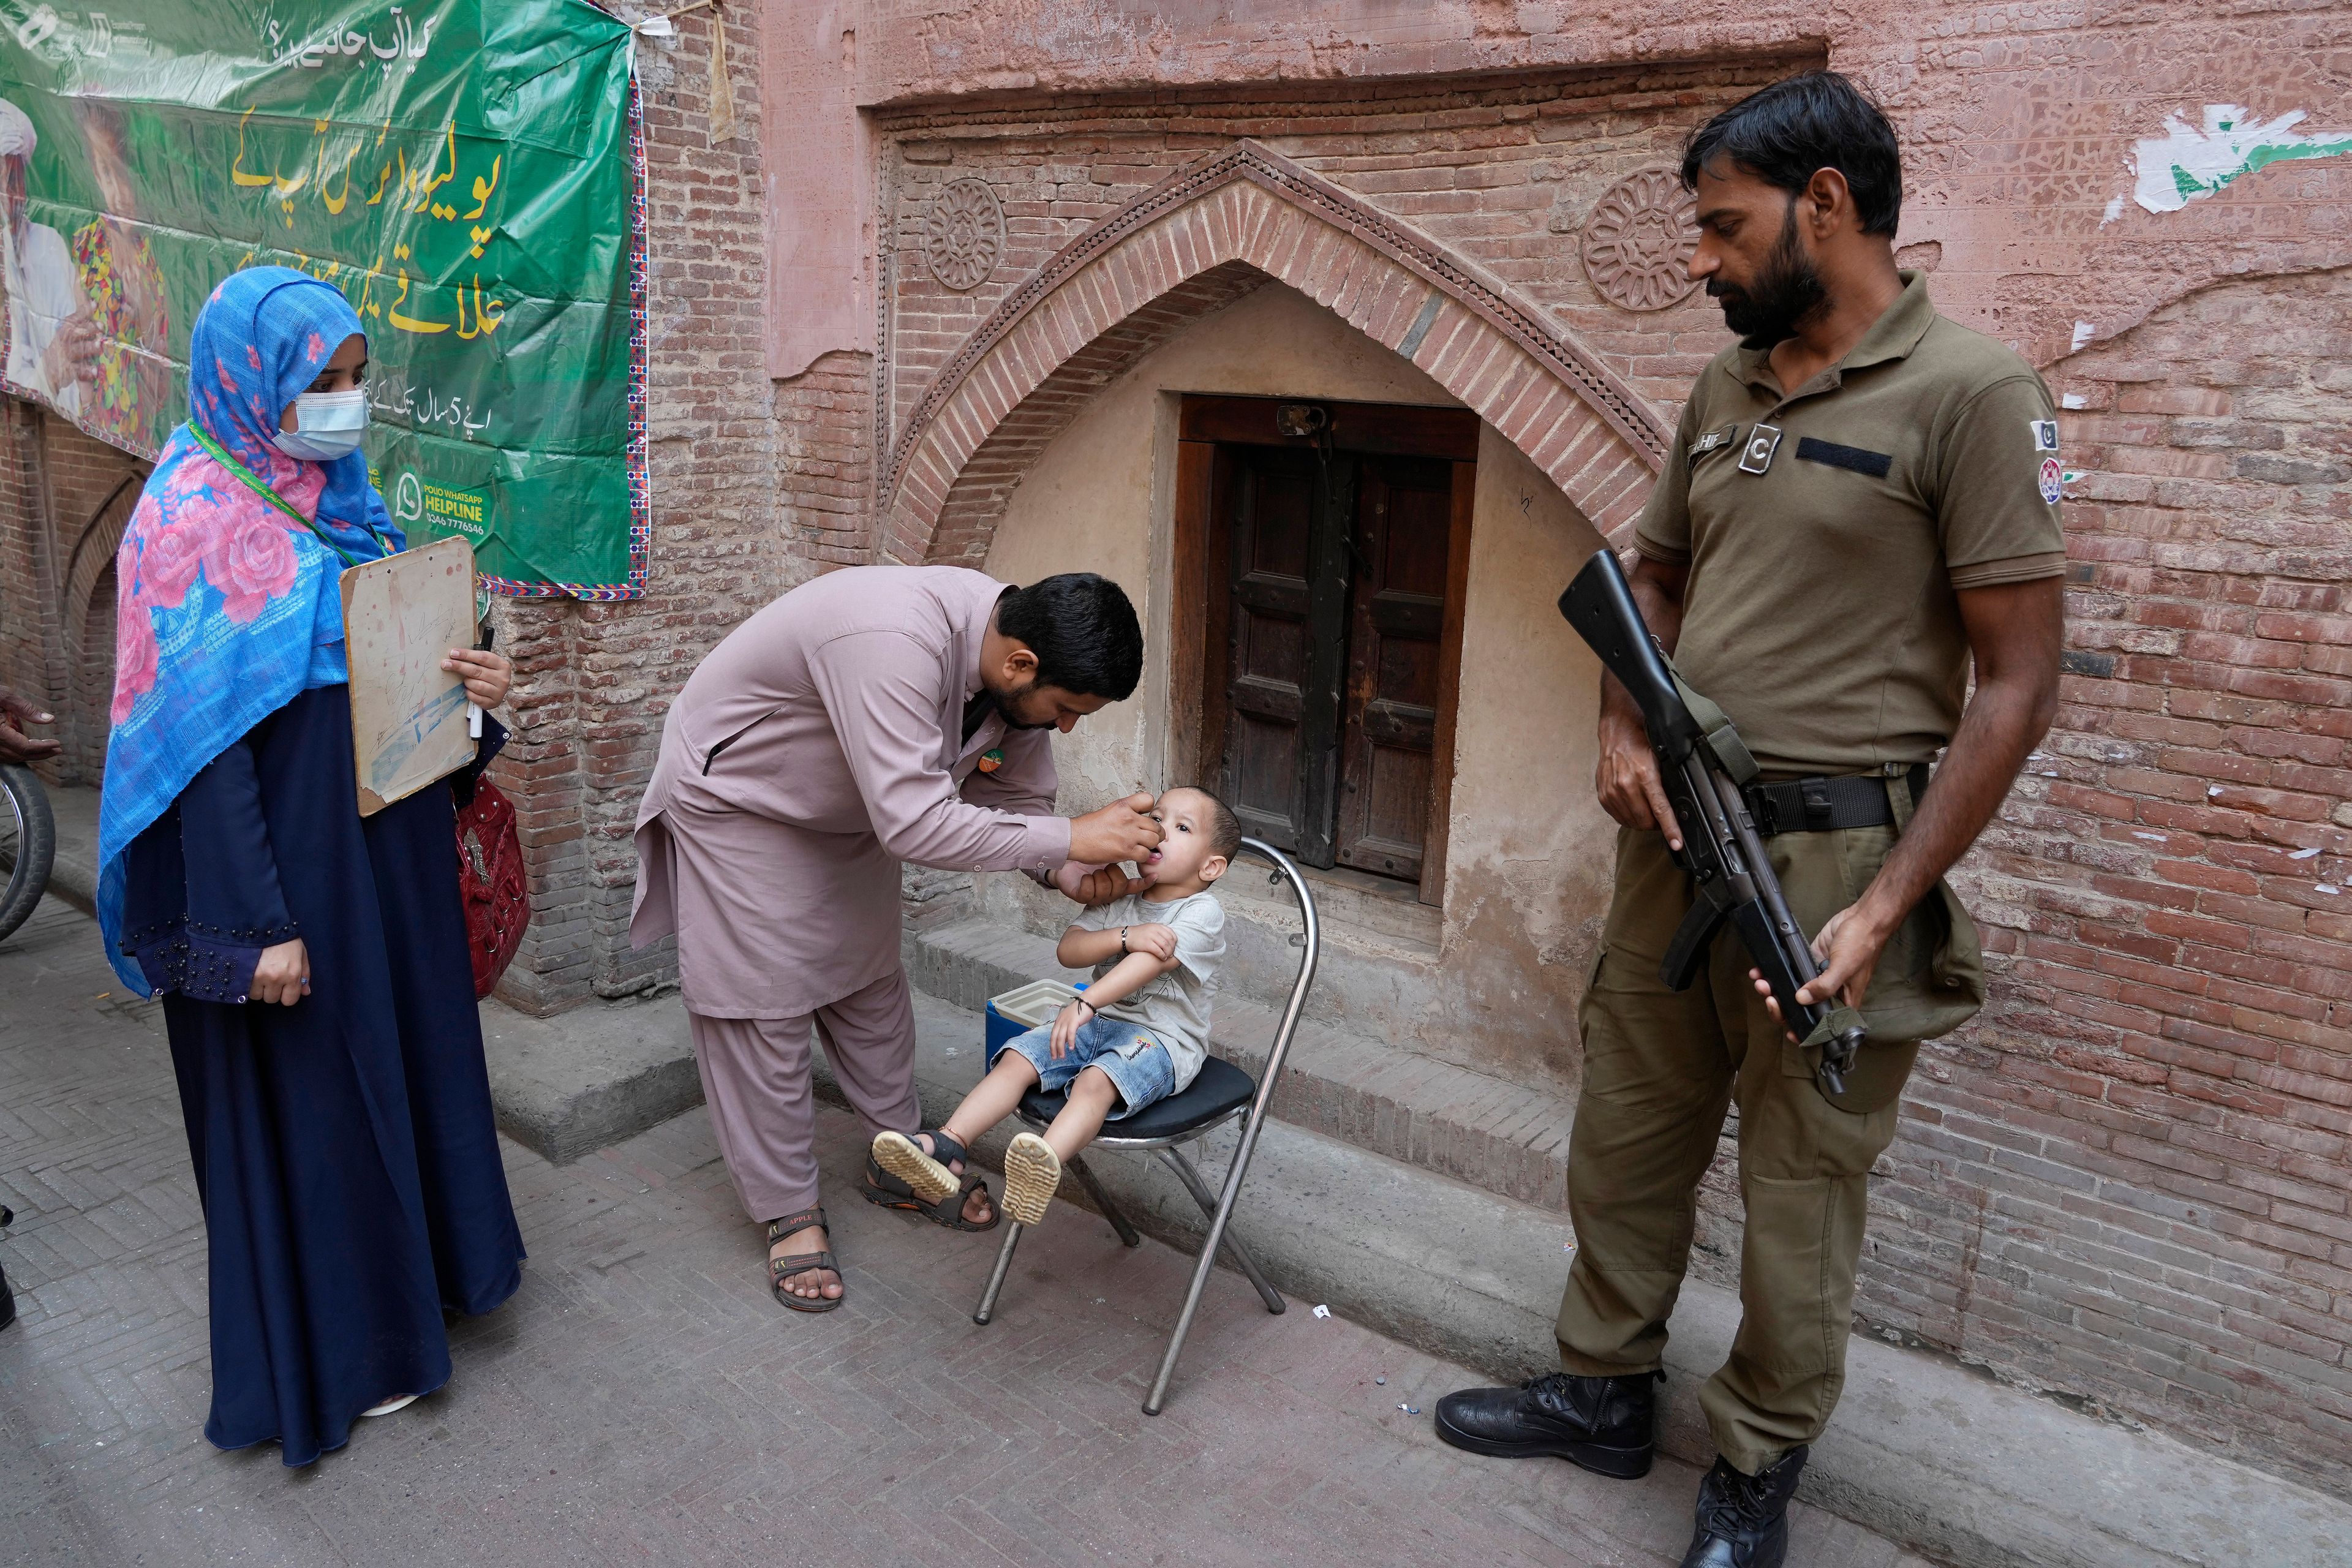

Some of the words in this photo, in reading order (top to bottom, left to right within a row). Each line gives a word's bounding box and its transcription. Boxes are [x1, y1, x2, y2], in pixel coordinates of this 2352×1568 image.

[369, 6, 405, 81] آپ
[405, 15, 438, 74] کیا
[232, 104, 274, 186] کے
[275, 114, 331, 229] آپ
[323, 118, 418, 215] وائرس
[414, 119, 501, 259] پولیو
[388, 243, 505, 340] علاقے
[373, 379, 392, 409] کے
[393, 386, 417, 416] تک
[417, 387, 449, 424] سال
[450, 396, 461, 425] 5
[462, 404, 491, 441] اپنے
[1750, 438, 1769, 459] C
[424, 484, 443, 497] POLIO
[444, 489, 483, 505] WHATSAPP
[425, 495, 483, 522] HELPLINE
[426, 513, 447, 526] 0346
[447, 518, 484, 535] 7776546
